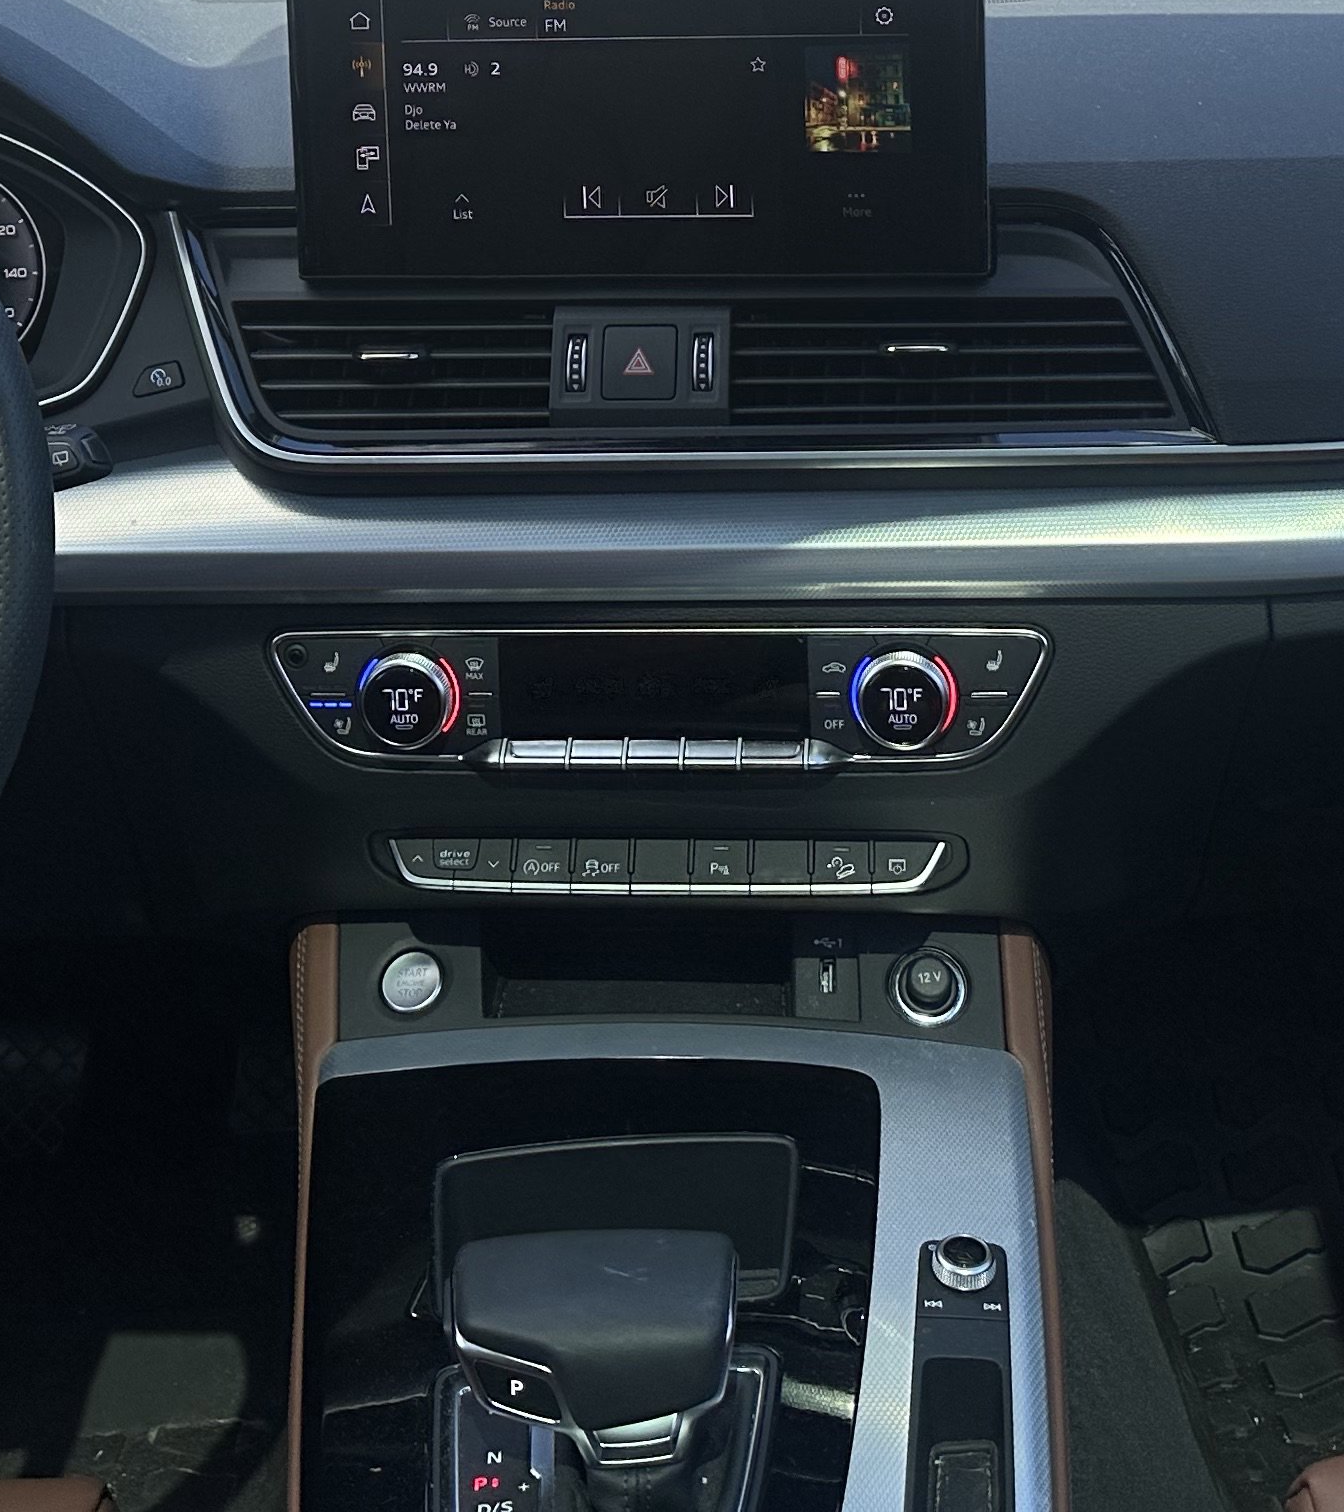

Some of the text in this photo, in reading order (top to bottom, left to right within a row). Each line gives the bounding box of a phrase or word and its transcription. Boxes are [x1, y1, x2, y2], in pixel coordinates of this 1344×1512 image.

[543, 0, 576, 11] Radio
[488, 16, 528, 28] Source
[544, 18, 567, 33] FM
[402, 62, 439, 77] 94.9
[490, 62, 501, 76] 2
[403, 82, 446, 93] WWRM
[404, 104, 423, 117] Djo
[405, 119, 457, 131] Delete Ya
[453, 209, 473, 220] List
[842, 206, 872, 218] More
[3, 267, 28, 278] 140
[465, 672, 484, 680] MAX
[390, 714, 419, 724] AUTO
[824, 719, 845, 730] OFF
[888, 714, 918, 724] AUTO
[466, 728, 488, 736] REAR
[439, 849, 471, 858] drive
[439, 857, 470, 867] select
[540, 863, 560, 873] OFF
[600, 863, 620, 873] OFF
[398, 967, 428, 977] START
[918, 970, 942, 984] 12 V
[398, 988, 423, 997] STOP
[510, 1379, 524, 1396] P
[487, 1450, 502, 1465] N
